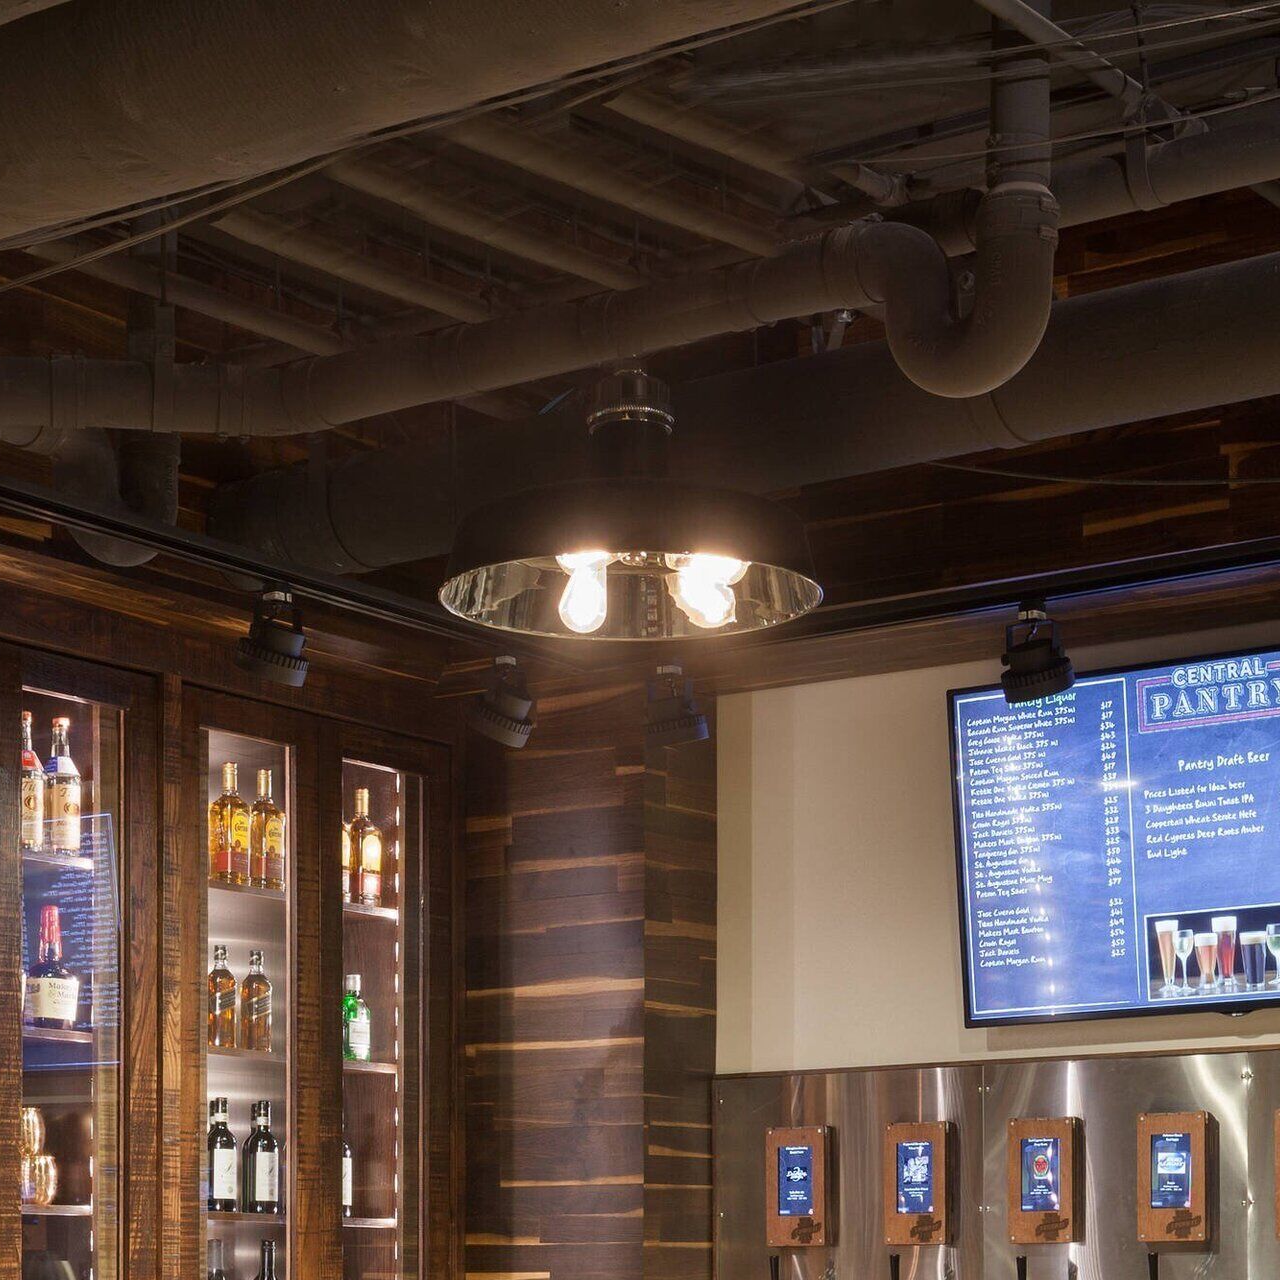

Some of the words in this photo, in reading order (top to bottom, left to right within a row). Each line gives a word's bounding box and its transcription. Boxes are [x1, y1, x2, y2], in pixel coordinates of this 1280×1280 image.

[1172, 658, 1265, 686] CENTRAL
[1046, 693, 1076, 704] Liquor
[1178, 760, 1213, 772] Pantry
[1217, 755, 1244, 767] Draft
[1248, 752, 1270, 762] Beer
[1144, 789, 1166, 799] Prices
[1169, 786, 1195, 796] Listed
[1197, 784, 1207, 793] for
[1229, 781, 1246, 789] beer
[1145, 805, 1151, 814] 3
[1153, 801, 1193, 814] Daughters
[1195, 798, 1216, 808] Bimini
[1242, 794, 1254, 803] IPA
[1146, 818, 1183, 829] Coppertail
[1185, 815, 1210, 826] Wheat
[1239, 810, 1257, 818] Hefe
[1147, 835, 1162, 844] Red
[1165, 833, 1195, 843] Cypress
[1197, 831, 1215, 839] Deep
[1218, 828, 1240, 836] Roots
[1241, 825, 1264, 834] Amber
[1147, 849, 1162, 859] Bud
[1164, 848, 1188, 859] Light
